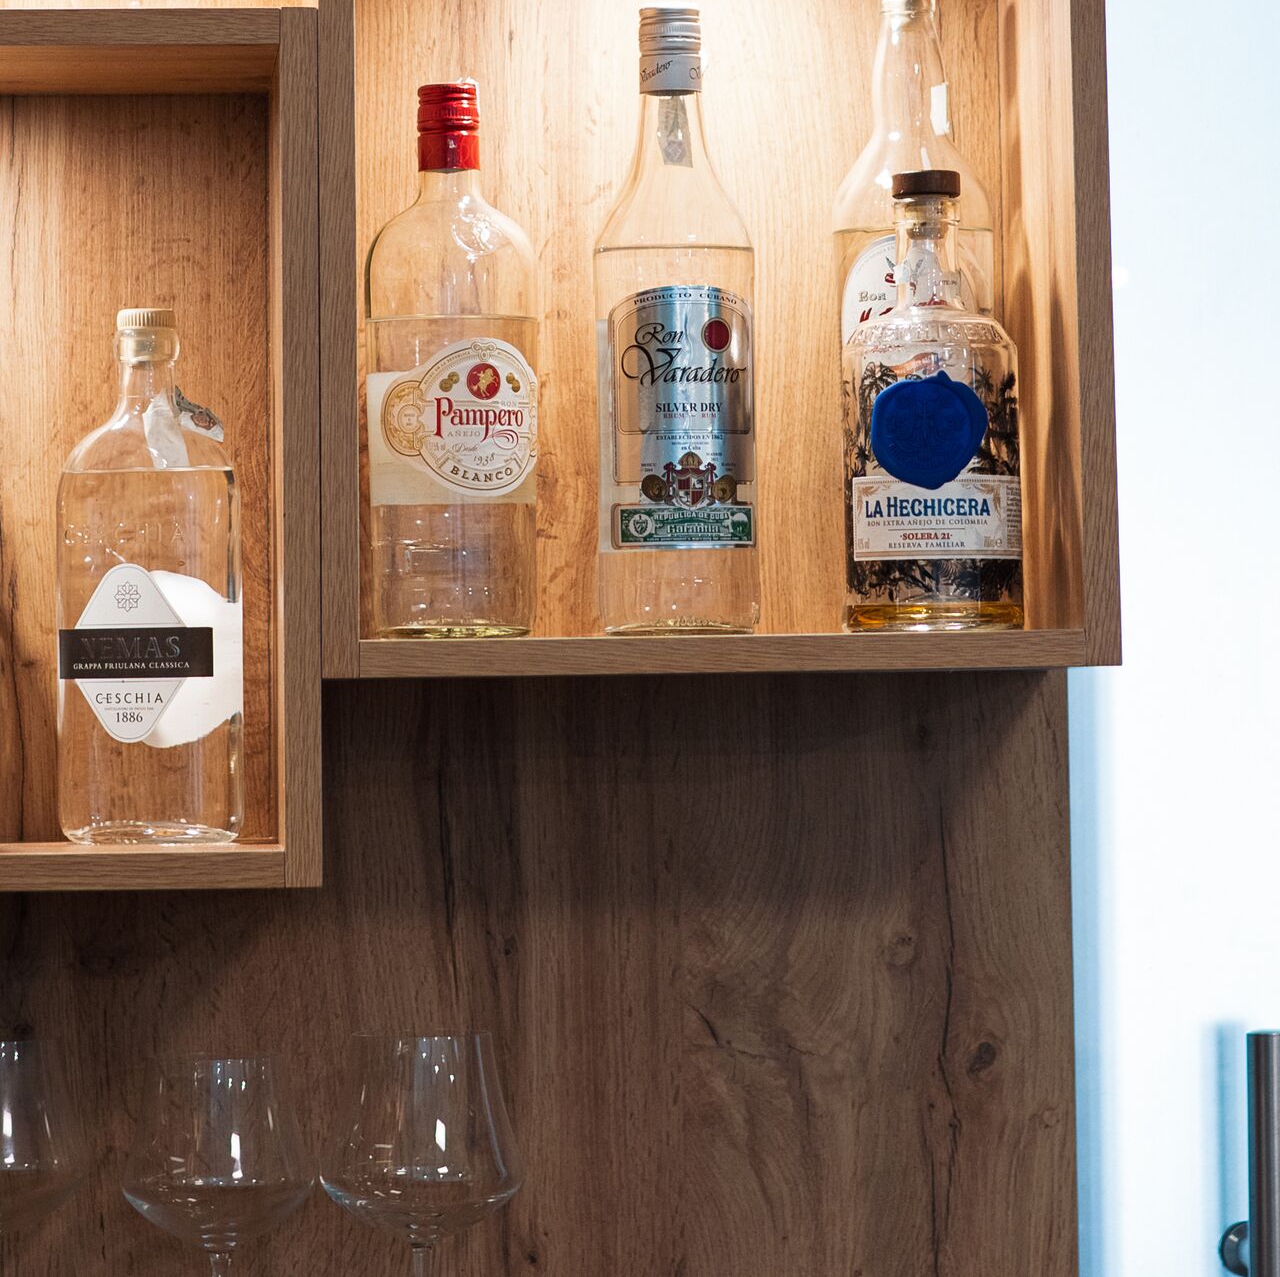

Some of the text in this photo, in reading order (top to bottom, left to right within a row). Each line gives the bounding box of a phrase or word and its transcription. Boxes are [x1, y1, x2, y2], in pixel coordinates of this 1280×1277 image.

[633, 292, 737, 306] PRODUCTO CUBANO
[635, 322, 684, 345] Ron
[621, 344, 747, 387] Varadero
[655, 402, 723, 413] SILVER DRY
[433, 396, 524, 444] Pampero
[447, 429, 481, 438] AÑEJO
[473, 452, 496, 466] 1938
[450, 465, 514, 483] BLANCO
[865, 496, 991, 519] LA HECHICERA
[908, 518, 933, 526] AÑEJO
[888, 541, 922, 549] RESERVA
[80, 636, 181, 660] NEMAS
[73, 661, 190, 670] GRAPPA FRIULANA CLASSICA
[95, 692, 164, 705] CESCHIA
[116, 712, 143, 723] 1886
